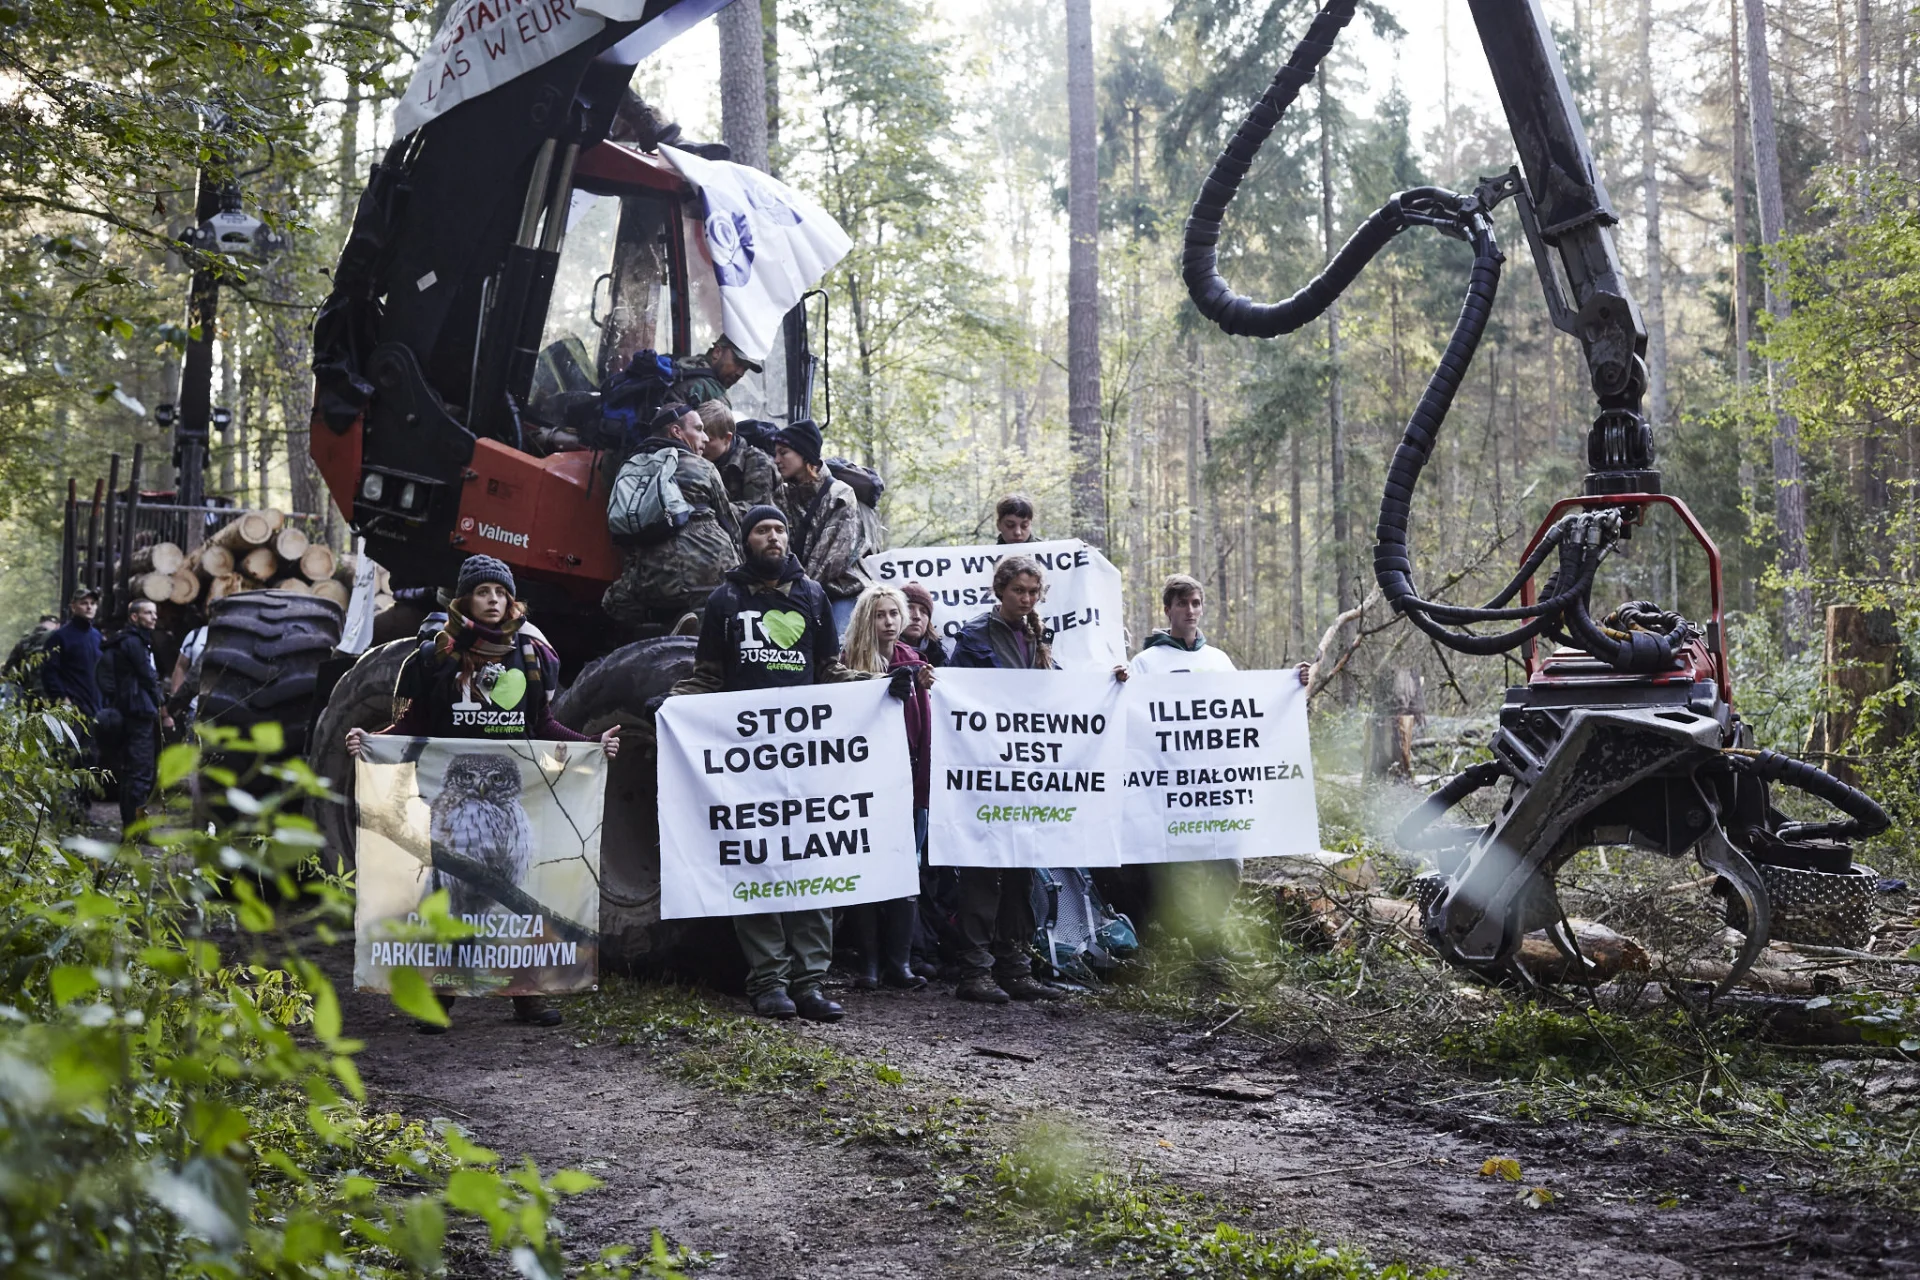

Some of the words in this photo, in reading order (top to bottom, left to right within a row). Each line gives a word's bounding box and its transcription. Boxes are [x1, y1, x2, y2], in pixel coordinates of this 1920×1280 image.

[420, 50, 471, 105] LAS
[484, 28, 506, 61] W
[517, 0, 575, 43] EUR
[478, 522, 529, 549] Valmet
[880, 558, 951, 580] STOP
[961, 550, 1089, 574] WYNCE
[737, 610, 763, 649] I
[452, 711, 525, 725] PUSZCZA
[737, 704, 832, 737] STOP
[951, 711, 987, 732] TO
[996, 712, 1106, 735] DREWNO
[1149, 698, 1264, 722] ILLEGAL
[1000, 742, 1062, 763] JEST
[1155, 727, 1260, 752] TIMBER
[704, 736, 869, 774] LOGGING
[946, 769, 1105, 792] NIELEGALNE
[1124, 769, 1168, 787] AVE
[1176, 761, 1304, 786] BIAŁOWIEŻA
[709, 792, 874, 830] RESPECT
[1166, 789, 1253, 808] FOREST!
[976, 804, 1077, 823] GREENPEACE
[1168, 818, 1255, 836] GREENPEACE
[719, 838, 768, 866] EU
[781, 828, 871, 861] LAW!
[733, 875, 861, 902] GREENPEACE
[371, 941, 452, 967] PARKIEM
[458, 941, 577, 968] NARODOWYM
